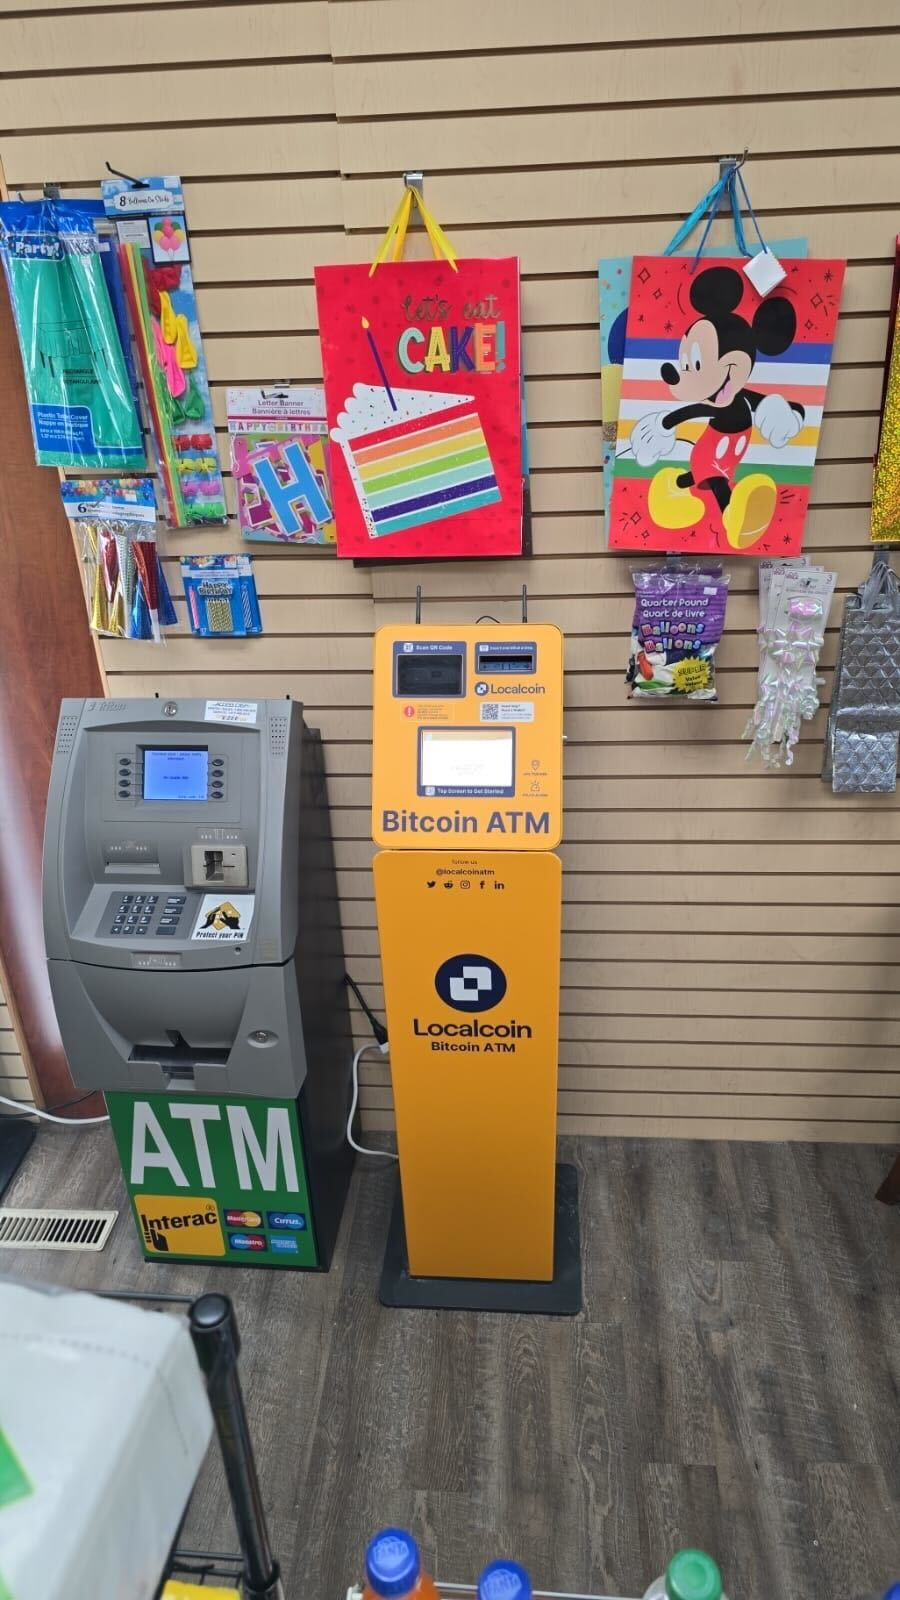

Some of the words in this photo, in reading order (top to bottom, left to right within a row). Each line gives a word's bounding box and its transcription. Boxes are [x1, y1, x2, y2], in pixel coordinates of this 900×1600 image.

[119, 196, 127, 207] 8
[16, 241, 60, 257] Party!
[464, 295, 501, 320] eat
[397, 321, 506, 374] CAKE!
[258, 399, 278, 408] Letter
[280, 400, 304, 408] Banner
[252, 408, 281, 416] Bannière
[290, 408, 311, 416] lettres
[229, 421, 267, 433] HAPPY
[77, 503, 87, 513] 6
[641, 599, 677, 607] Quarter
[679, 598, 709, 606] Pound
[643, 610, 670, 618] Quart
[641, 621, 704, 637] Balloons
[644, 637, 702, 653] Ballons
[491, 683, 545, 694] Localcoin
[382, 810, 478, 832] Bitcoin
[486, 811, 550, 833] ATM
[436, 868, 495, 877] @localcoinatm
[413, 1018, 532, 1039] Localcoin
[431, 1041, 480, 1052] Bitcoin
[483, 1042, 516, 1053] ATM
[130, 1101, 300, 1193] ATM
[140, 1211, 218, 1231] Interac
[274, 1217, 299, 1225] Cirrus
